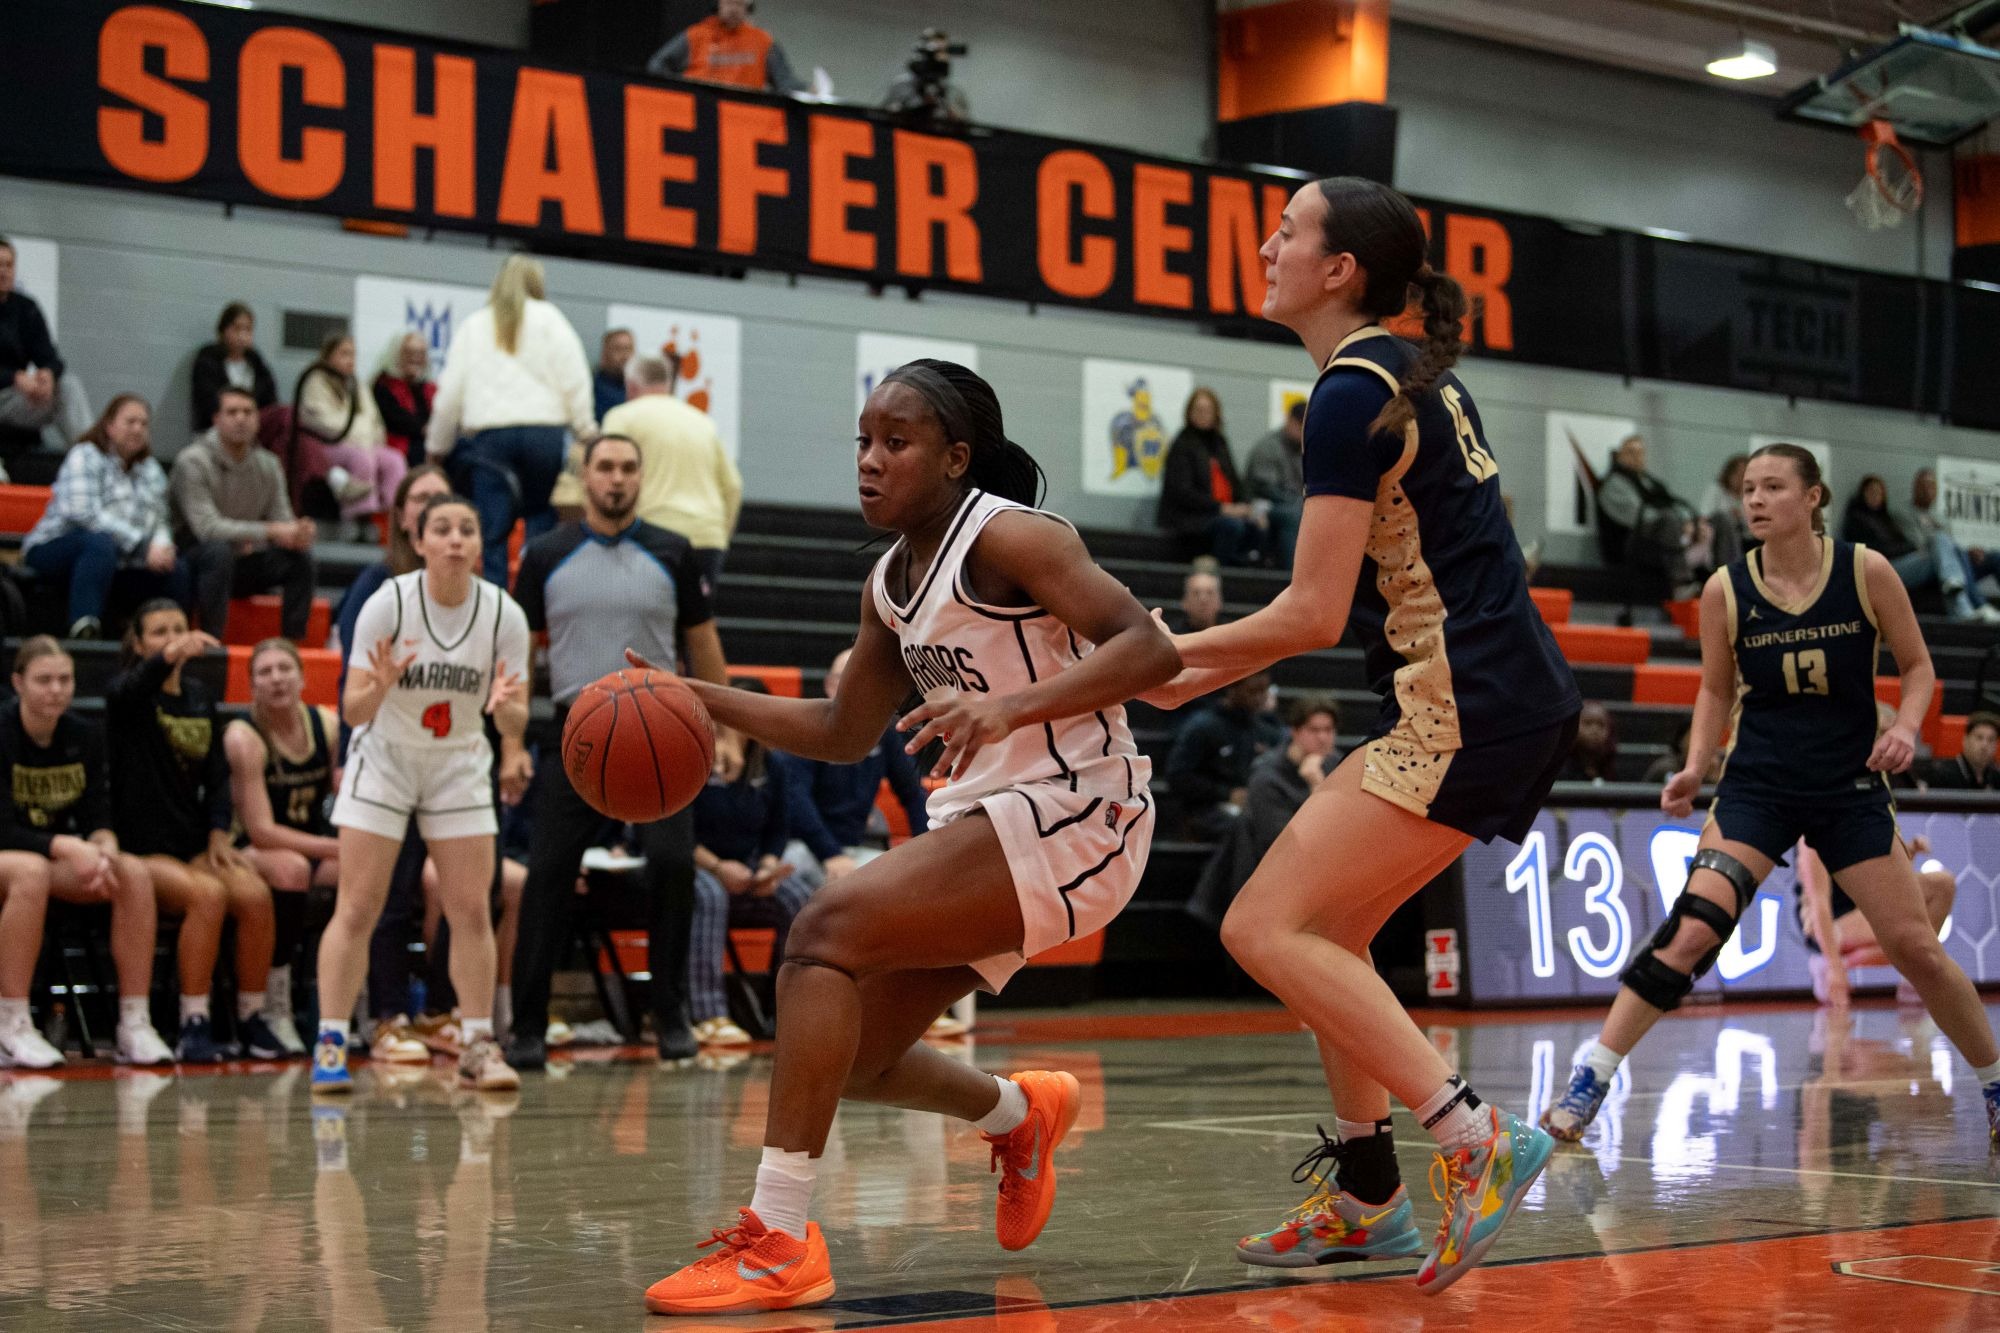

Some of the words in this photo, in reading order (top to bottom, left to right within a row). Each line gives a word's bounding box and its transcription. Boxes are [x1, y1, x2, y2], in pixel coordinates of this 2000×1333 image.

[98, 5, 983, 283] SCHAEFER
[1037, 150, 1512, 349] CENR
[1743, 620, 1862, 649] CORNERSTONE
[1781, 648, 1830, 697] 13
[421, 700, 452, 738] 4
[1505, 830, 1633, 979] 13
